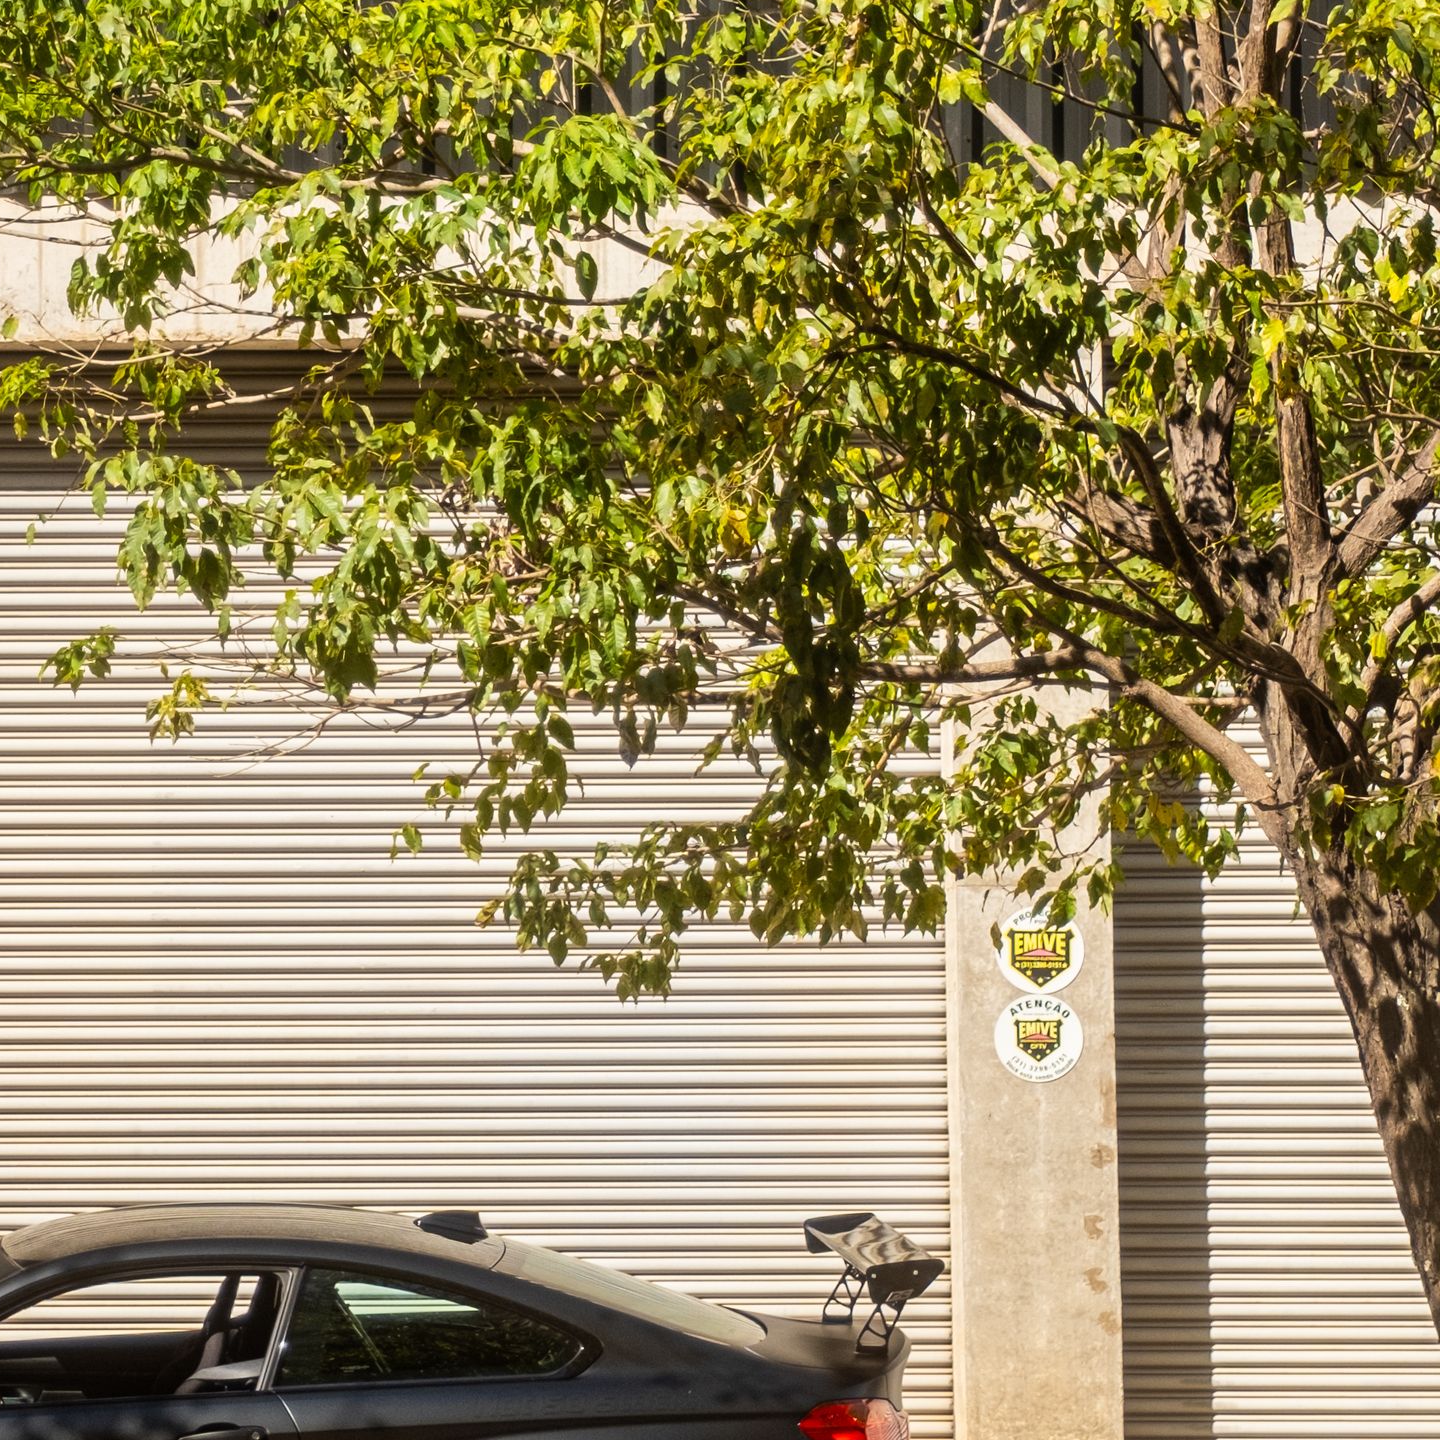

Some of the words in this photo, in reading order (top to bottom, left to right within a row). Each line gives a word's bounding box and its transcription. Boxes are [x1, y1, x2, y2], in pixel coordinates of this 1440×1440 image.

[1013, 932, 1066, 956] EMIVE
[1010, 999, 1072, 1018] ATENÇÃO
[1019, 1022, 1058, 1039] EMIVE
